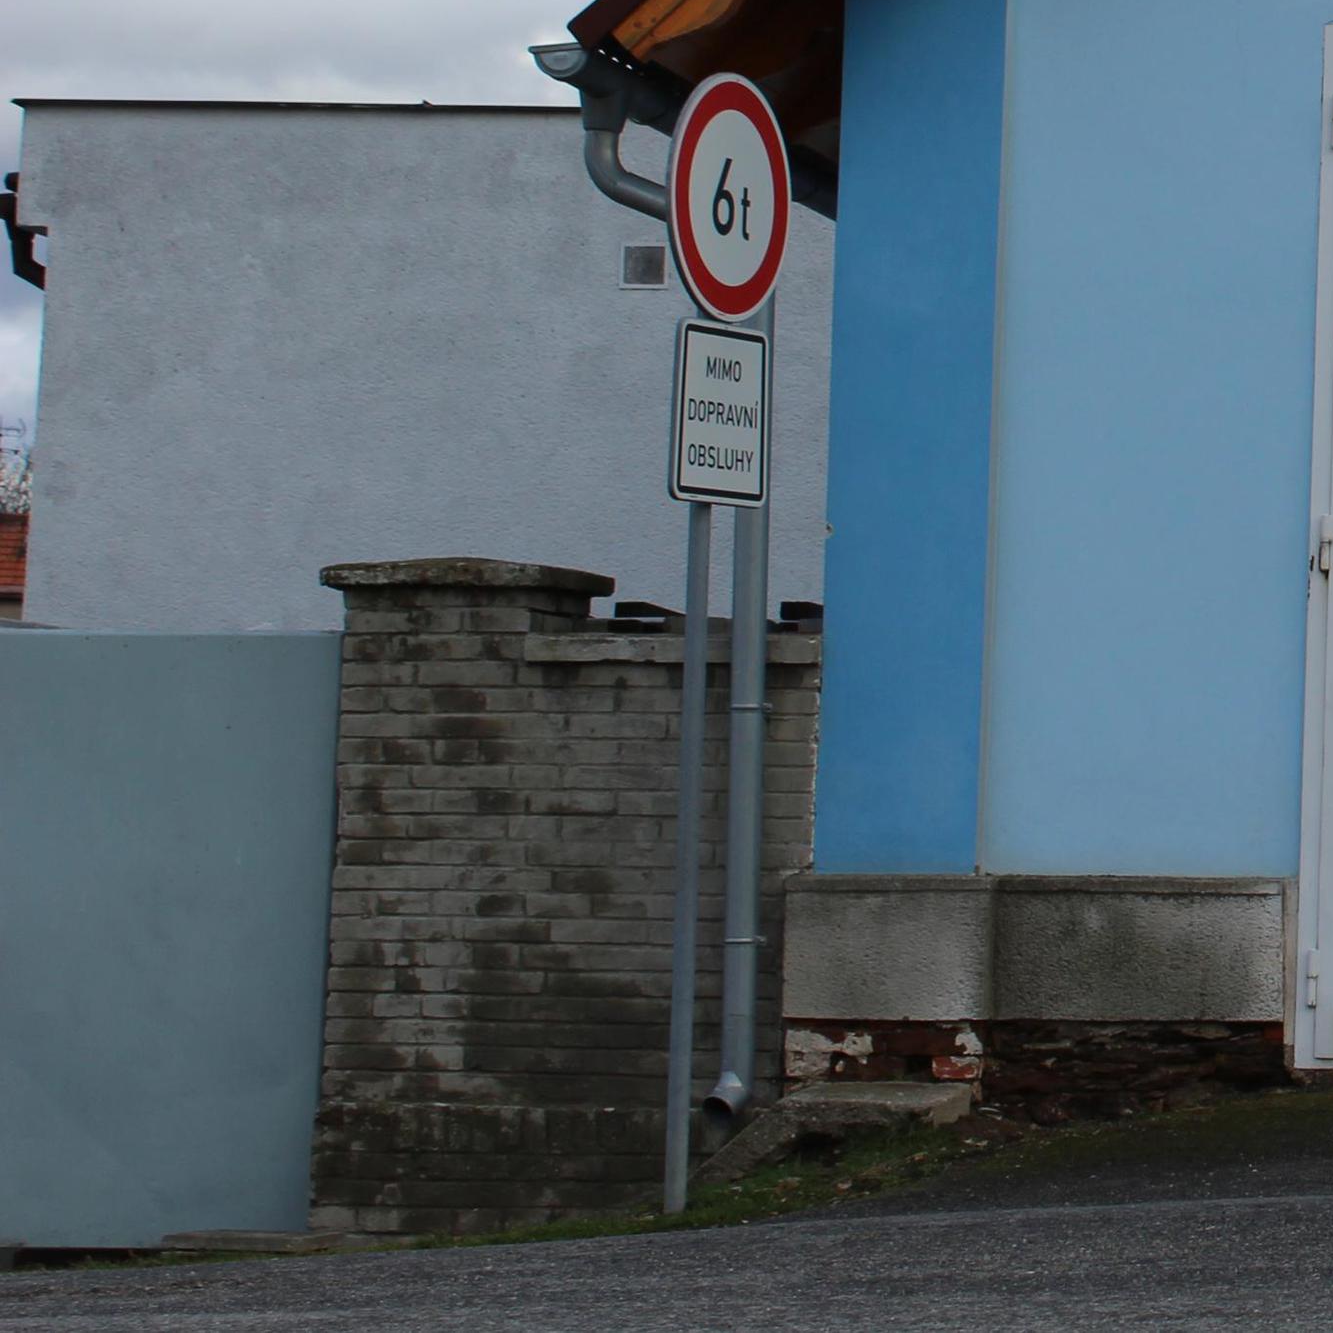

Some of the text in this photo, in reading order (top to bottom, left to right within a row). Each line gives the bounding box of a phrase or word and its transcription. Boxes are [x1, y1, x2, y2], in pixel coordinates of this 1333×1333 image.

[706, 356, 742, 382] MIMO
[688, 398, 758, 429] DOPRAVNÍ
[687, 443, 754, 473] OBSLUHY
